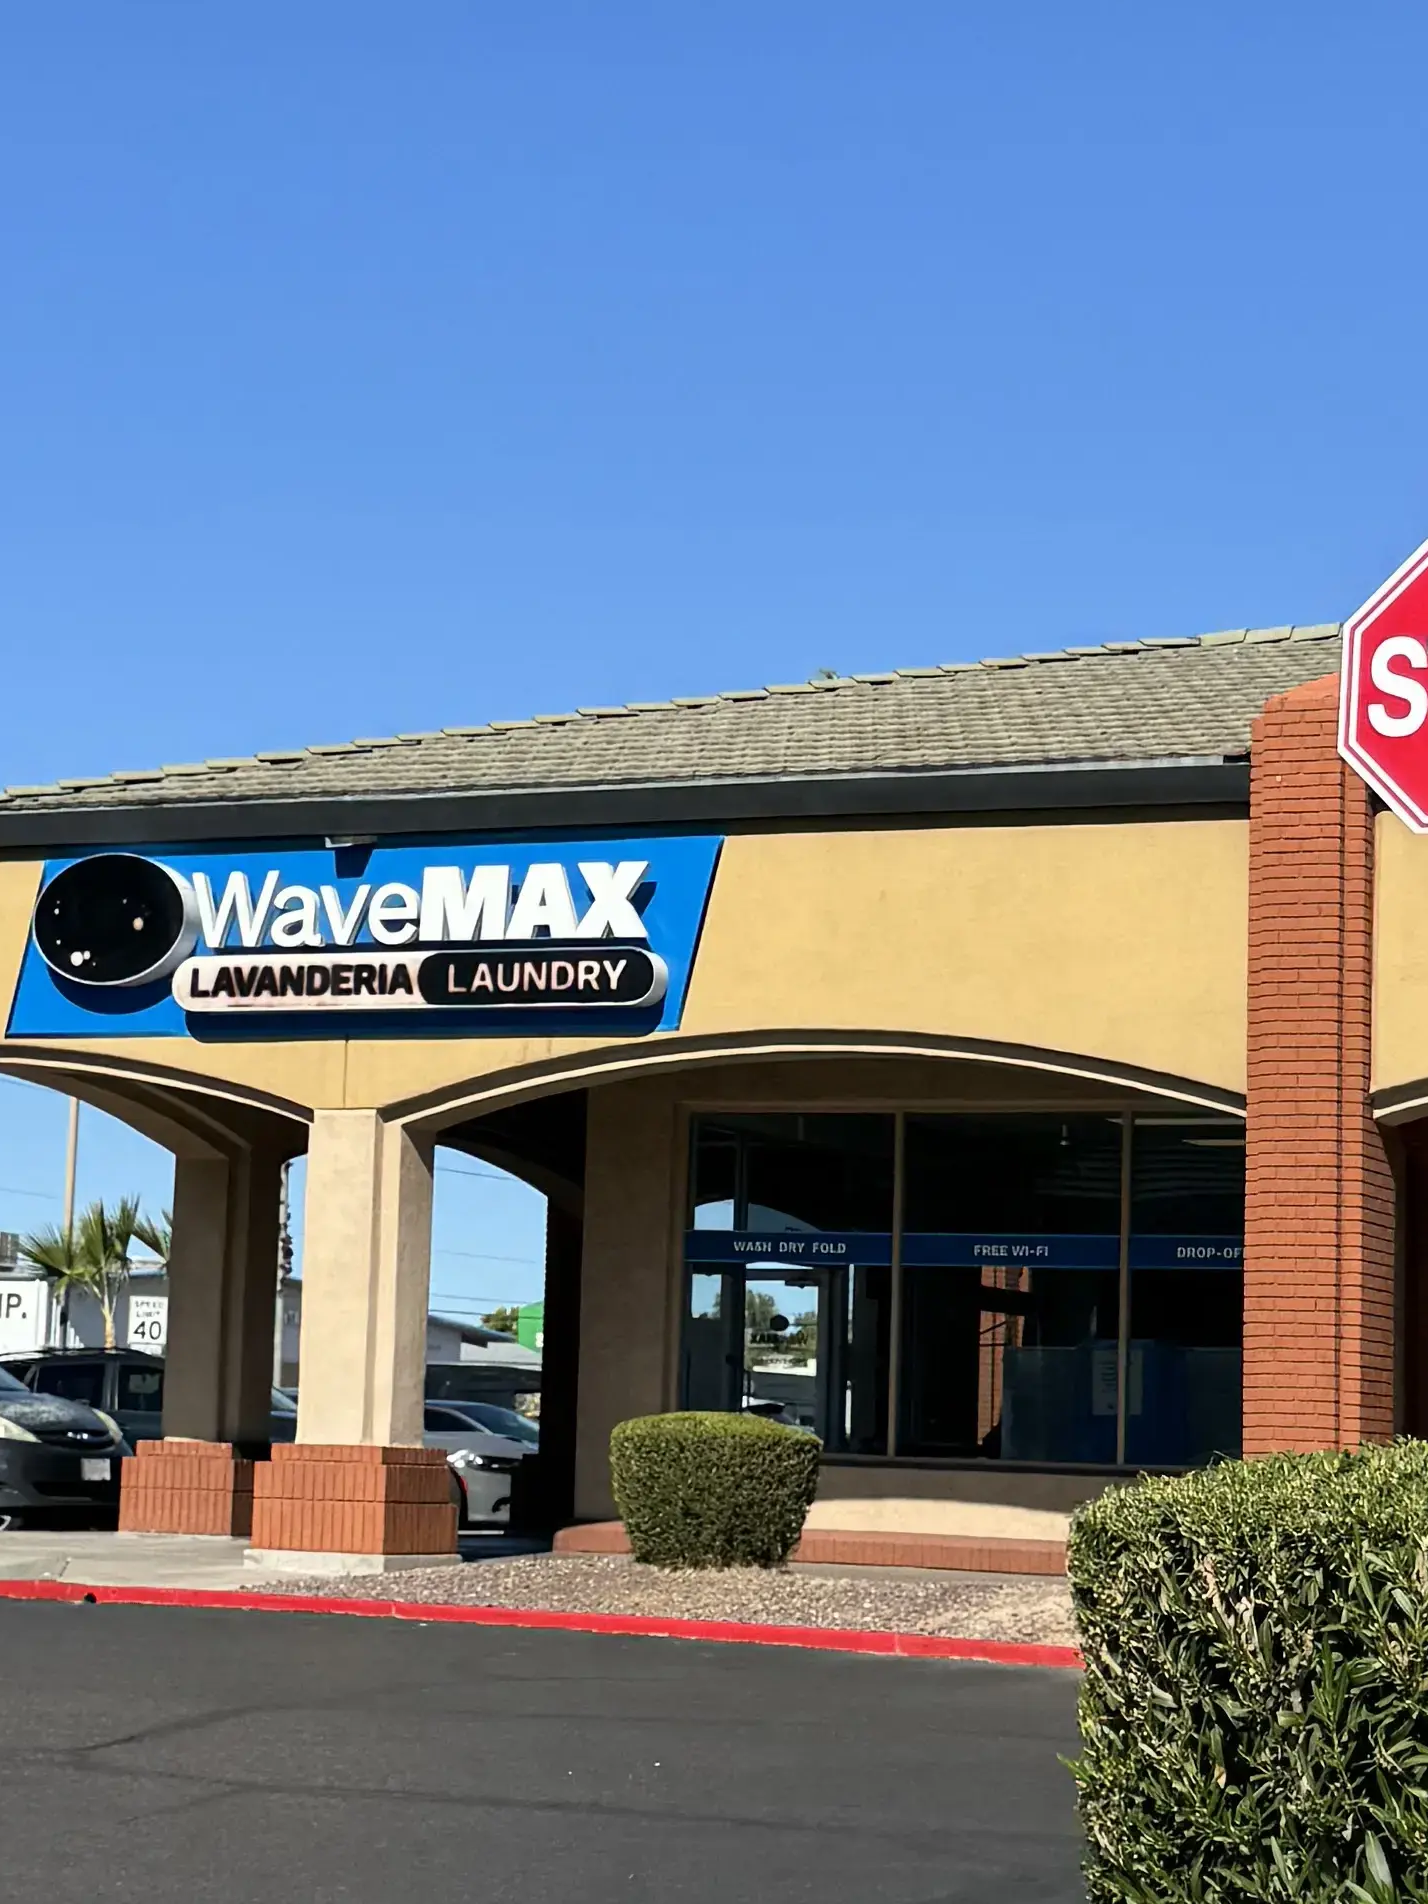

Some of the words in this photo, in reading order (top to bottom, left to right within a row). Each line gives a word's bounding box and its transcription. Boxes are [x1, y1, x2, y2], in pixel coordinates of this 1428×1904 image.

[192, 861, 650, 948] WaveMAX
[190, 963, 414, 998] LAVANDERIA
[447, 959, 628, 993] LAUNDRY
[733, 1241, 772, 1252] WASH
[779, 1241, 805, 1253] DRY
[812, 1242, 847, 1254] FOLD
[973, 1244, 1009, 1256] FREE
[1011, 1245, 1049, 1257] WI-FI
[1177, 1246, 1242, 1259] DROP-OF
[133, 1320, 162, 1341] 40
